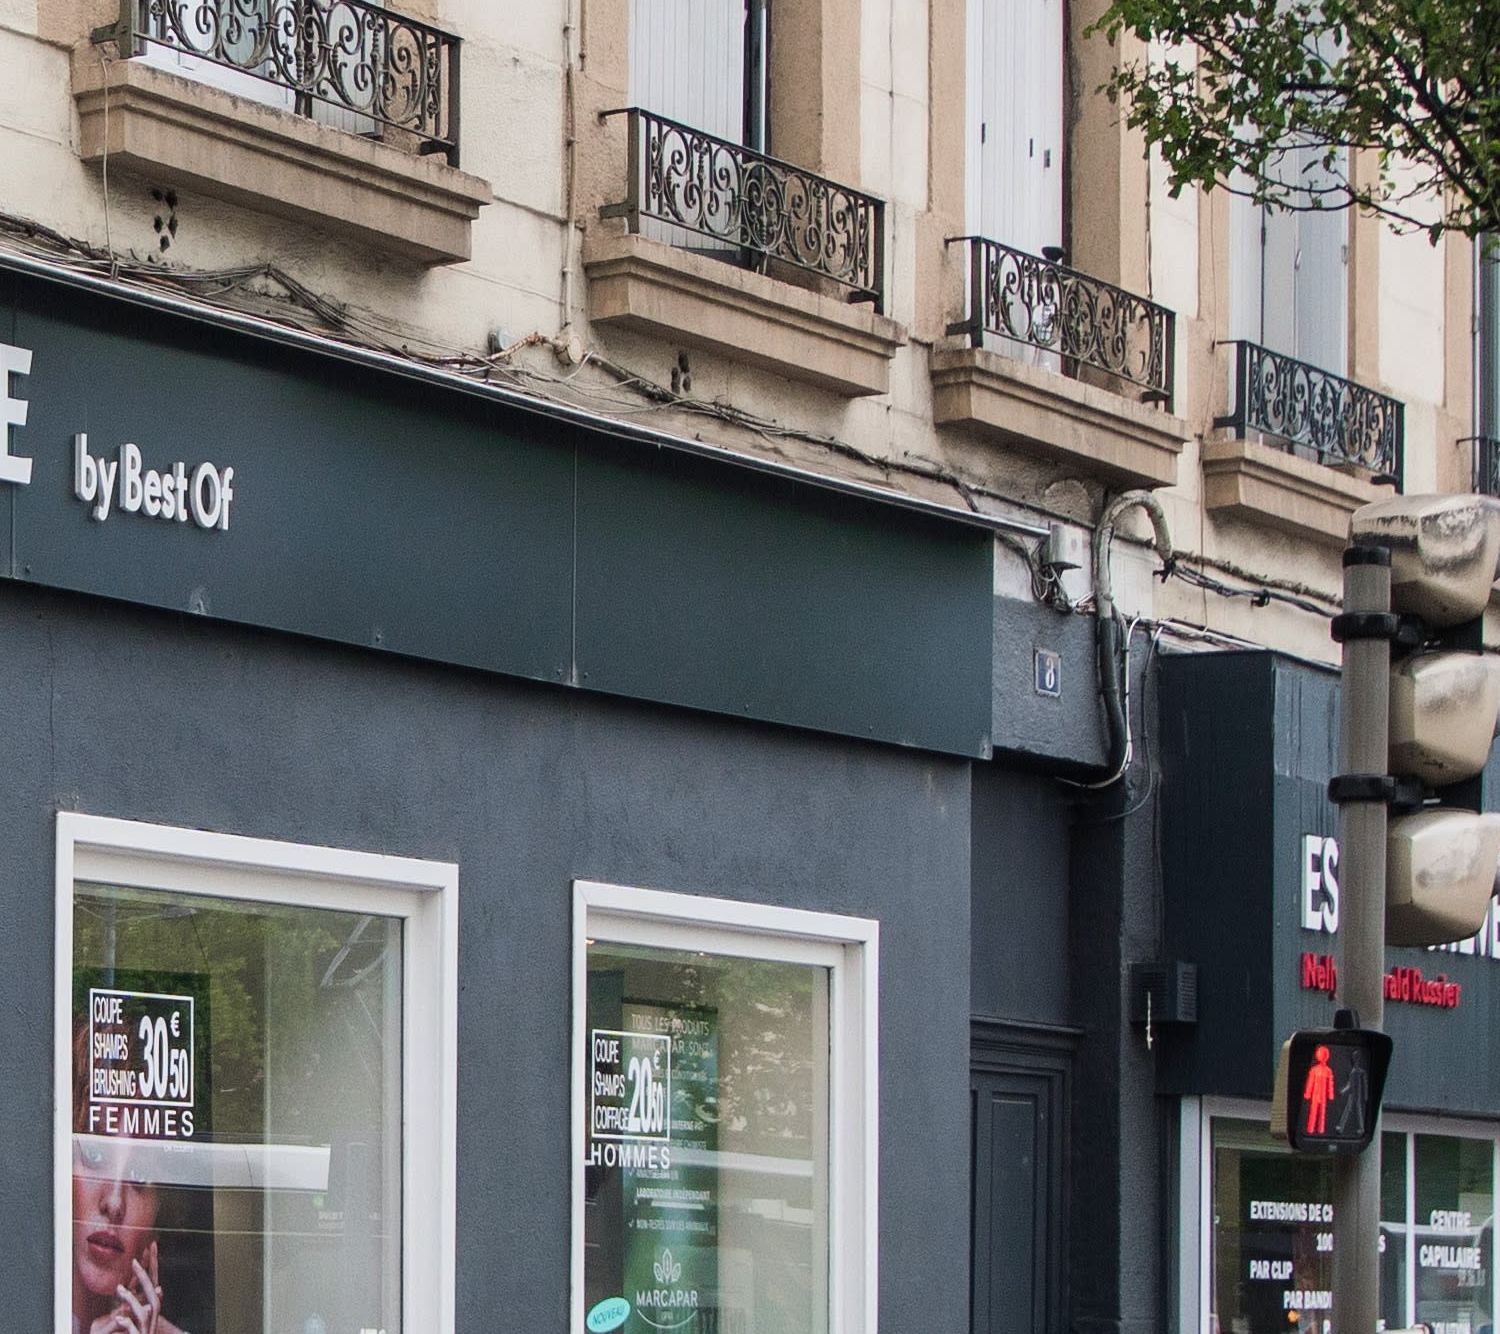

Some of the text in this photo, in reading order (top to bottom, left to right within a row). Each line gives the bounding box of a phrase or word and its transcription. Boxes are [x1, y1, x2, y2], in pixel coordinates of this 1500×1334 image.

[73, 433, 236, 531] by Best Of
[1413, 967, 1462, 1008] Russier
[93, 996, 124, 1025] COUPE
[594, 1038, 621, 1065] COUPE
[93, 1068, 137, 1098] BRUSHING
[89, 1105, 195, 1138] FEMMES
[590, 1142, 671, 1170] HOMMES
[1250, 1200, 1308, 1222] EXTENSIONS
[1309, 1202, 1322, 1222] DE
[1429, 1209, 1472, 1233] CENTRE
[1250, 1260, 1294, 1281] PAR CLIP
[1419, 1244, 1482, 1270] CAPILLAIRE
[635, 1289, 699, 1308] MARCAPAR
[1283, 1290, 1303, 1310] PAR
